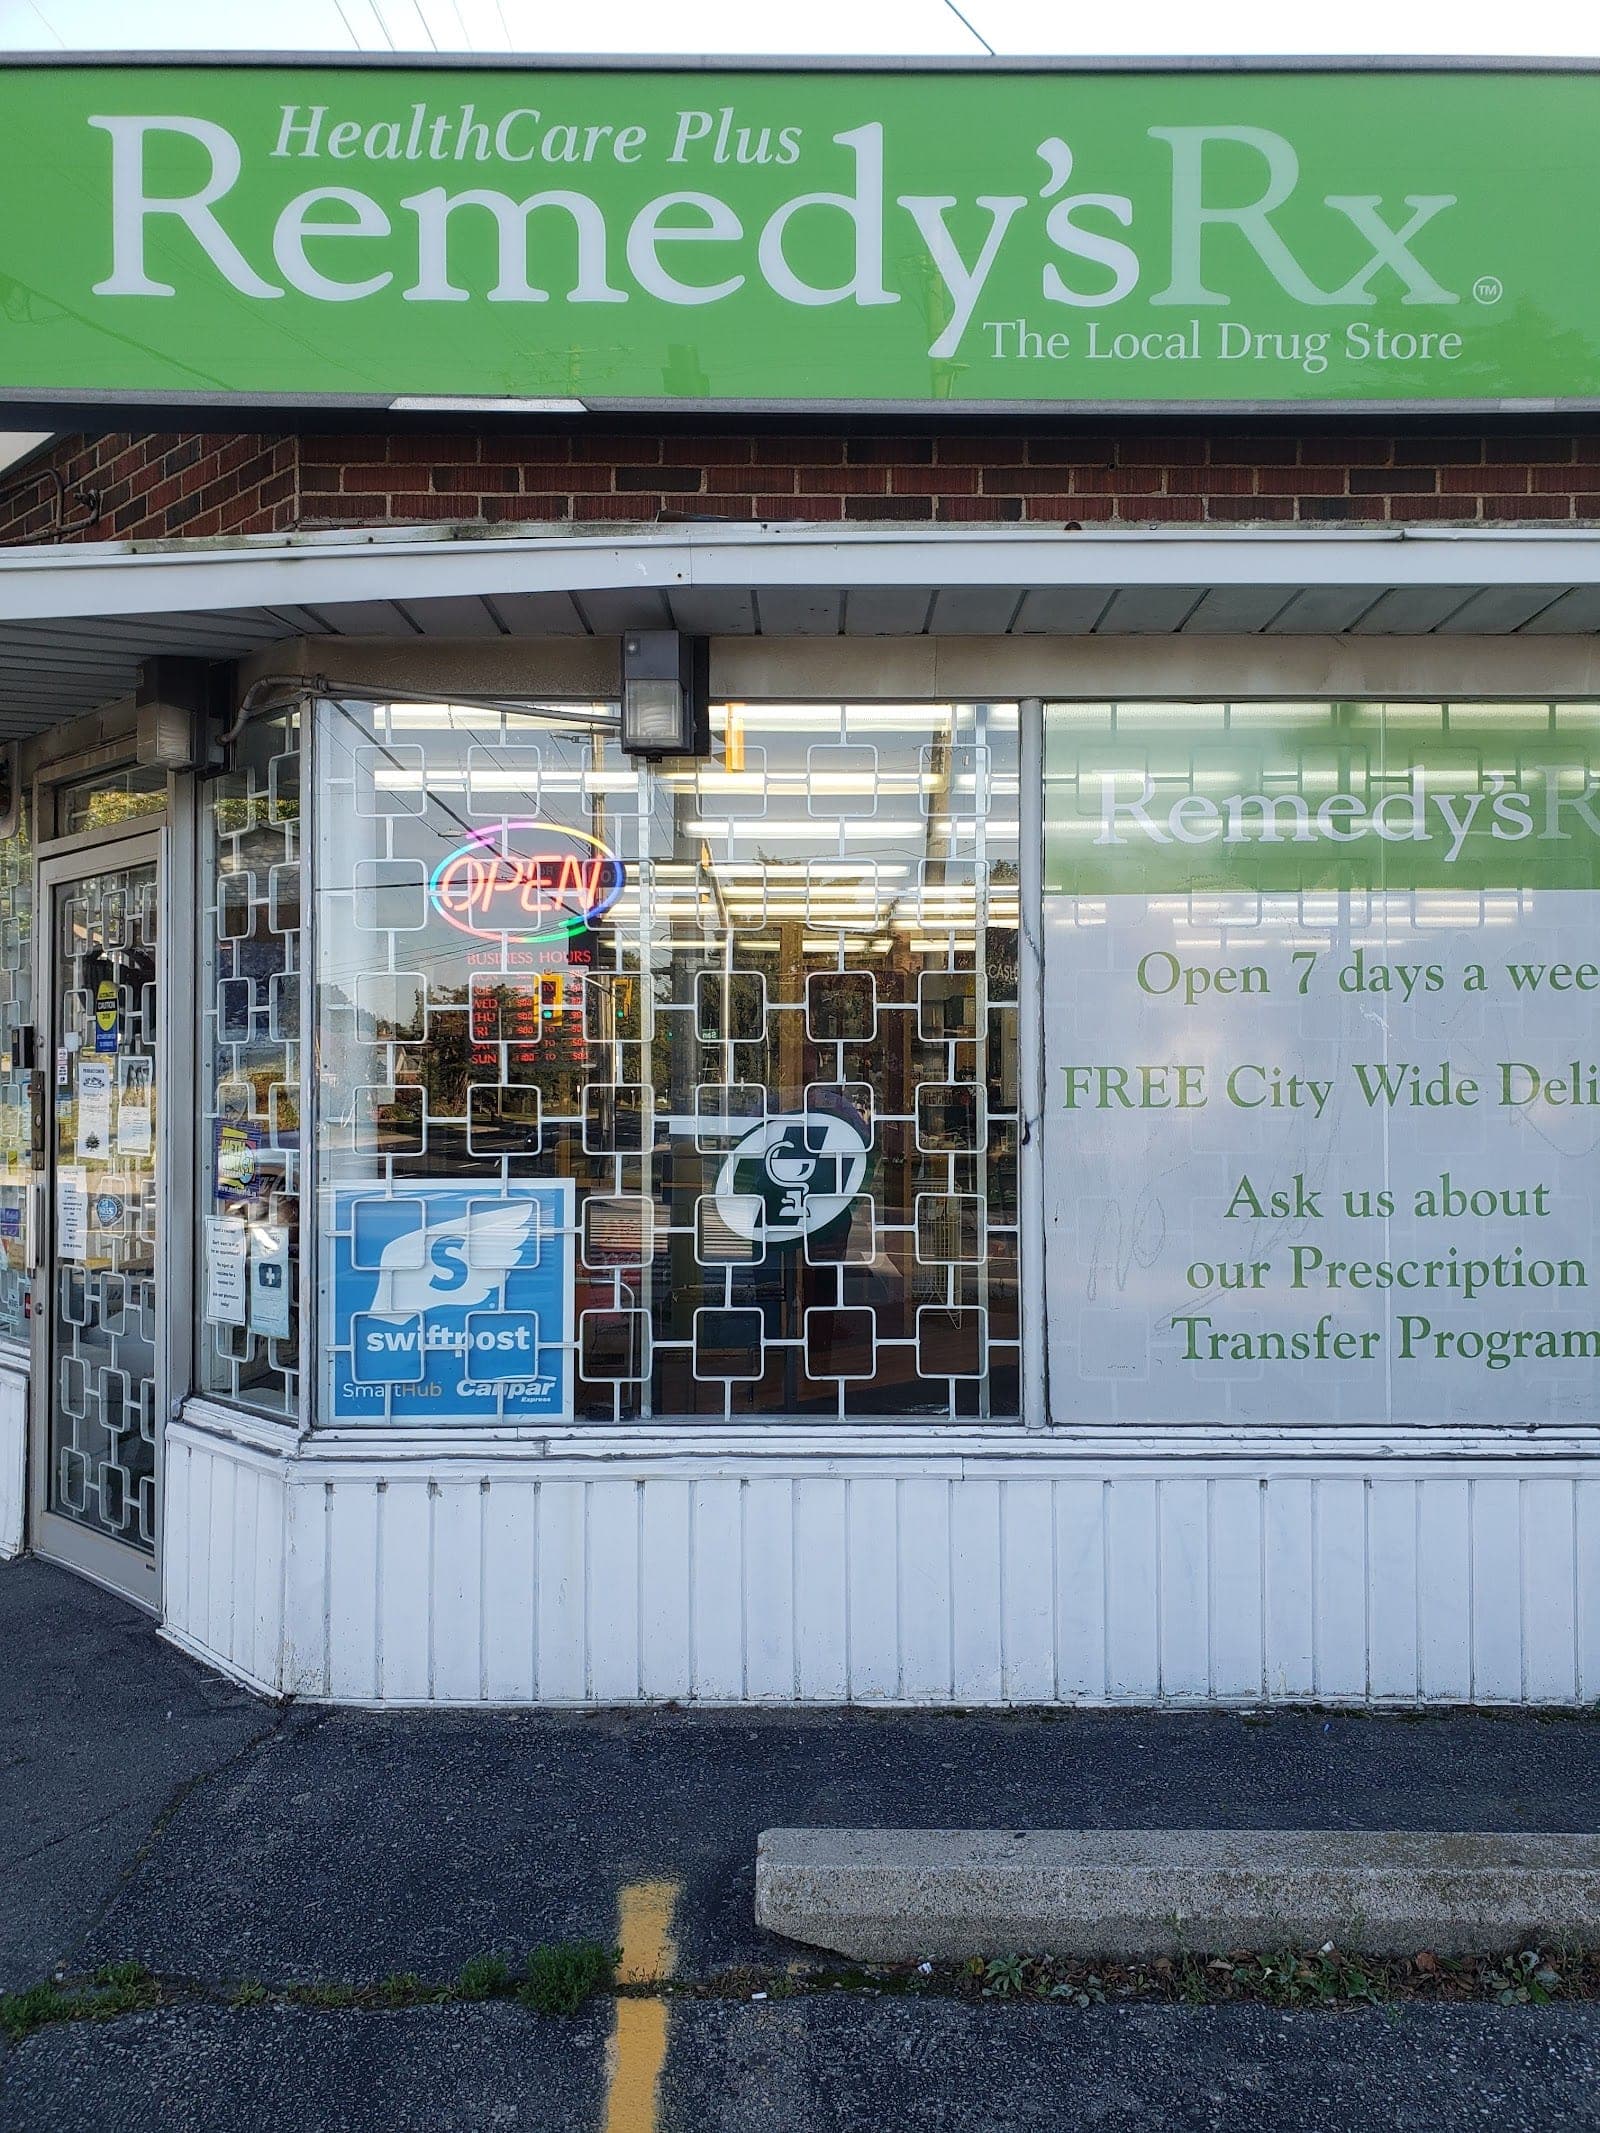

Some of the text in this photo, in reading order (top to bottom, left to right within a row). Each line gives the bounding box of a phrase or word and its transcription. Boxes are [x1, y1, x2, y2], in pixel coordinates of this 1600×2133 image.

[269, 104, 802, 166] HealthCare Plus
[983, 318, 1463, 373] The Local Drug Store
[442, 855, 603, 911] OPEN
[540, 950, 591, 964] HOURS
[1137, 951, 1270, 1005] Open
[1291, 952, 1317, 994] 7
[1338, 948, 1444, 1002] days
[1463, 964, 1488, 990] a
[471, 1053, 497, 1064] SUN
[1061, 1066, 1207, 1109] FREE
[1226, 1065, 1333, 1119] City
[1352, 1062, 1478, 1107] Wide
[1224, 1173, 1551, 1218] Ask us about
[1187, 1246, 1587, 1299] our Prescription
[1171, 1315, 1600, 1369] Transfer Program
